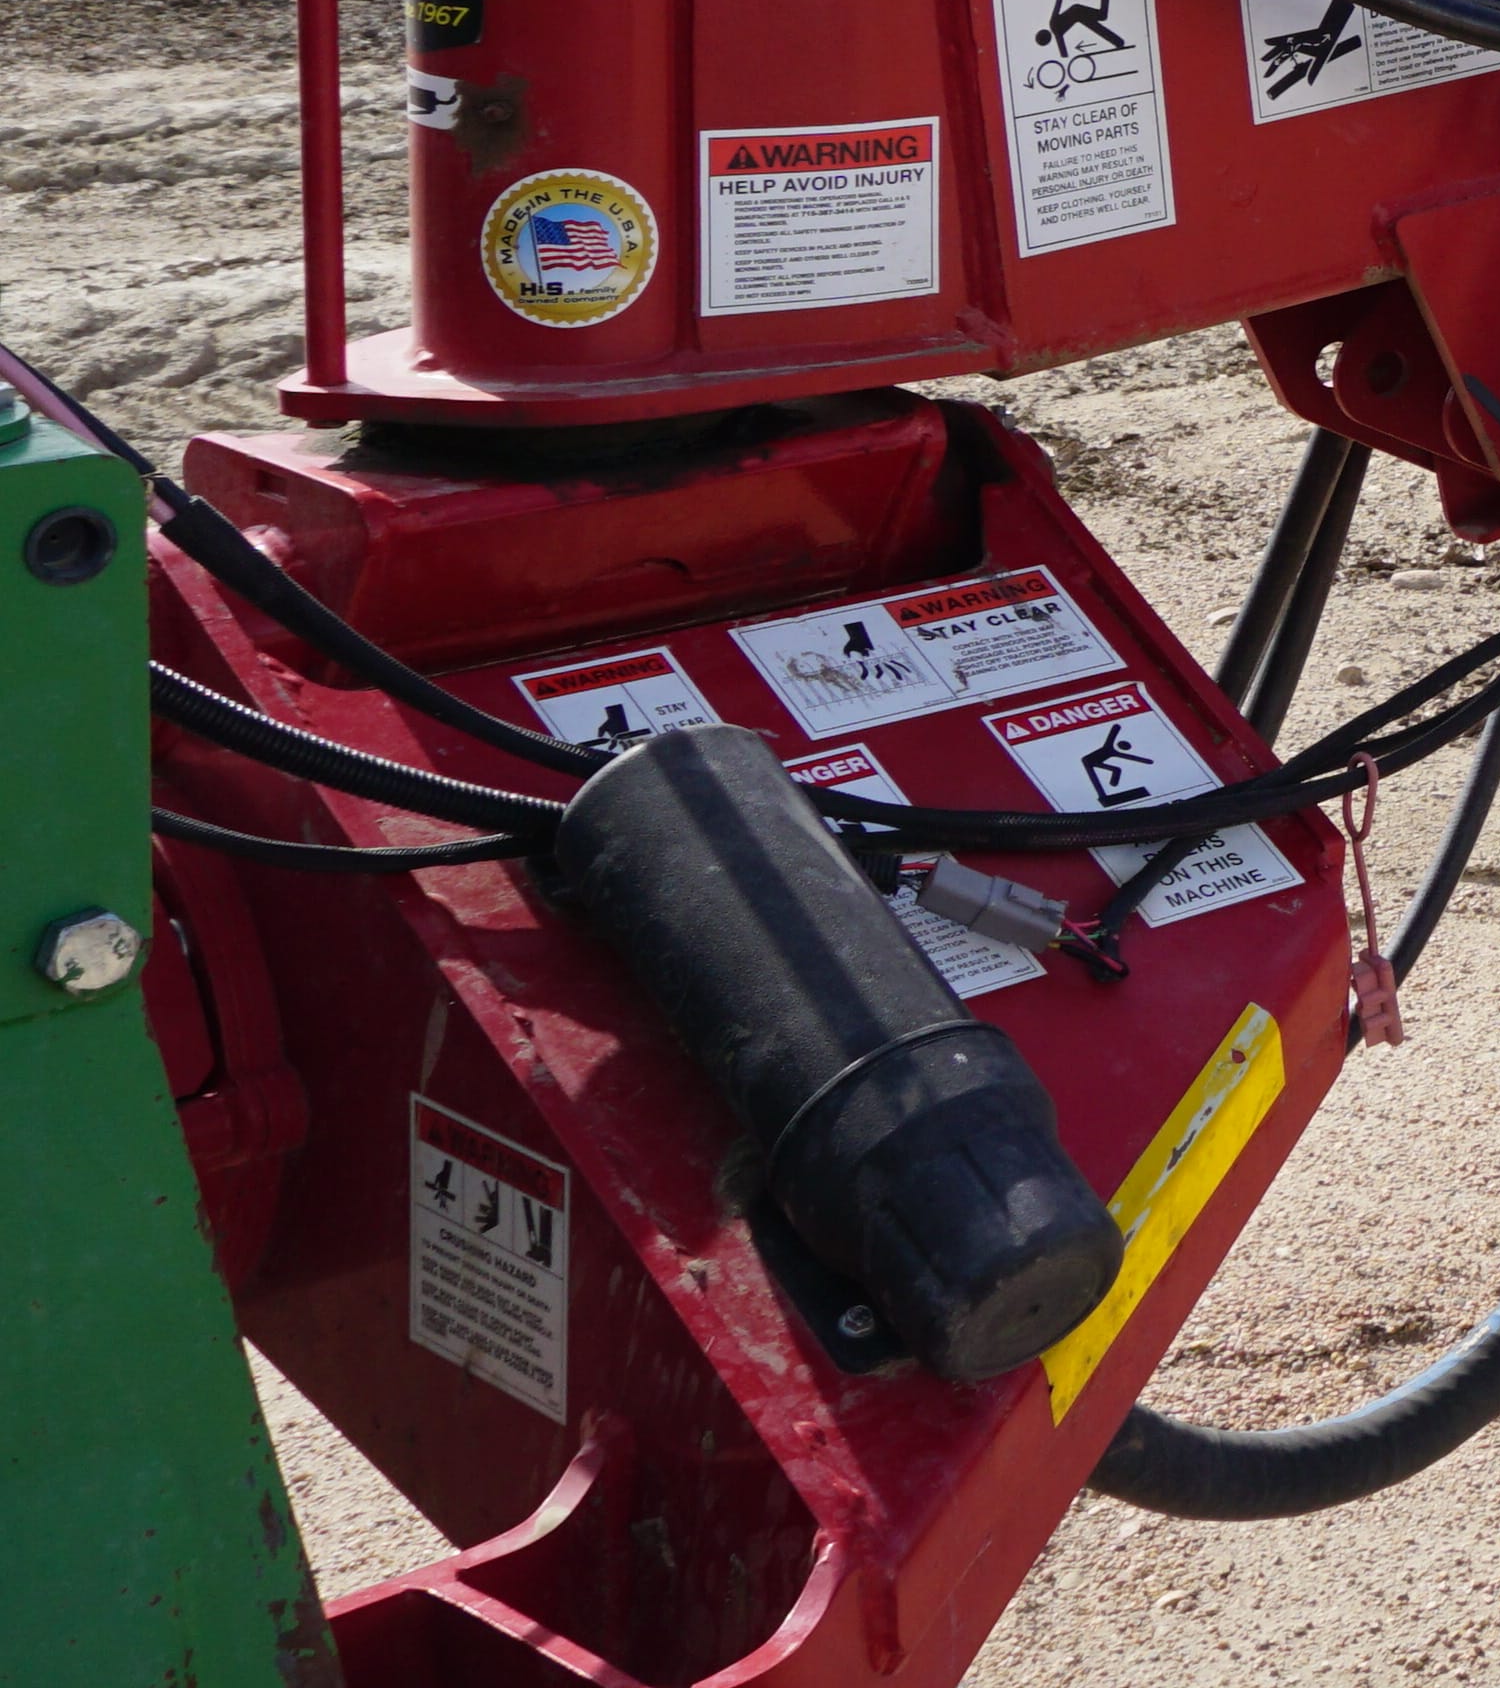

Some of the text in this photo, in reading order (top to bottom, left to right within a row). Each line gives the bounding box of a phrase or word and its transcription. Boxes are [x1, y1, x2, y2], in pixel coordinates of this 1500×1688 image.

[417, 2, 469, 27] 1967
[1034, 103, 1138, 134] STAY CLEAR OF
[761, 136, 918, 168] WARNING
[1037, 123, 1139, 153] MOVING PARTS
[1039, 168, 1079, 183] WARNING
[1082, 164, 1100, 174] MAY
[1102, 157, 1133, 169] RESULT
[1043, 145, 1137, 170] FAILURE TO HEED THIS
[719, 168, 925, 195] HELP AVOID INJURY
[1032, 165, 1153, 196] PERSONAL INJURY OR DEATH
[1037, 203, 1058, 214] KEEP
[1109, 184, 1152, 199] YOURSELF
[1040, 215, 1058, 225] AND
[1061, 208, 1094, 221] OTHERS
[1097, 203, 1118, 213] WELL
[502, 208, 526, 264] MADE
[530, 192, 551, 208] IN
[560, 189, 604, 204] THE
[564, 296, 620, 304] company
[579, 287, 617, 295] family
[920, 579, 1046, 615] WARNING
[919, 602, 1061, 641] STAY CLEAR
[953, 638, 991, 650] CONTACT
[994, 633, 1013, 641] WITH
[1004, 650, 1039, 661] TRACTOR
[1022, 640, 1052, 651] POWER
[1054, 635, 1071, 643] AND
[557, 658, 665, 690] WARNING
[1012, 653, 1055, 667] SERVICING
[655, 702, 688, 715] STAY
[1028, 694, 1140, 733] DANGER
[1158, 853, 1243, 887] ON THIS
[1164, 869, 1266, 908] MACHINE
[451, 1126, 551, 1199] WARNING
[439, 1226, 537, 1289] CRUSHING HAZARD
